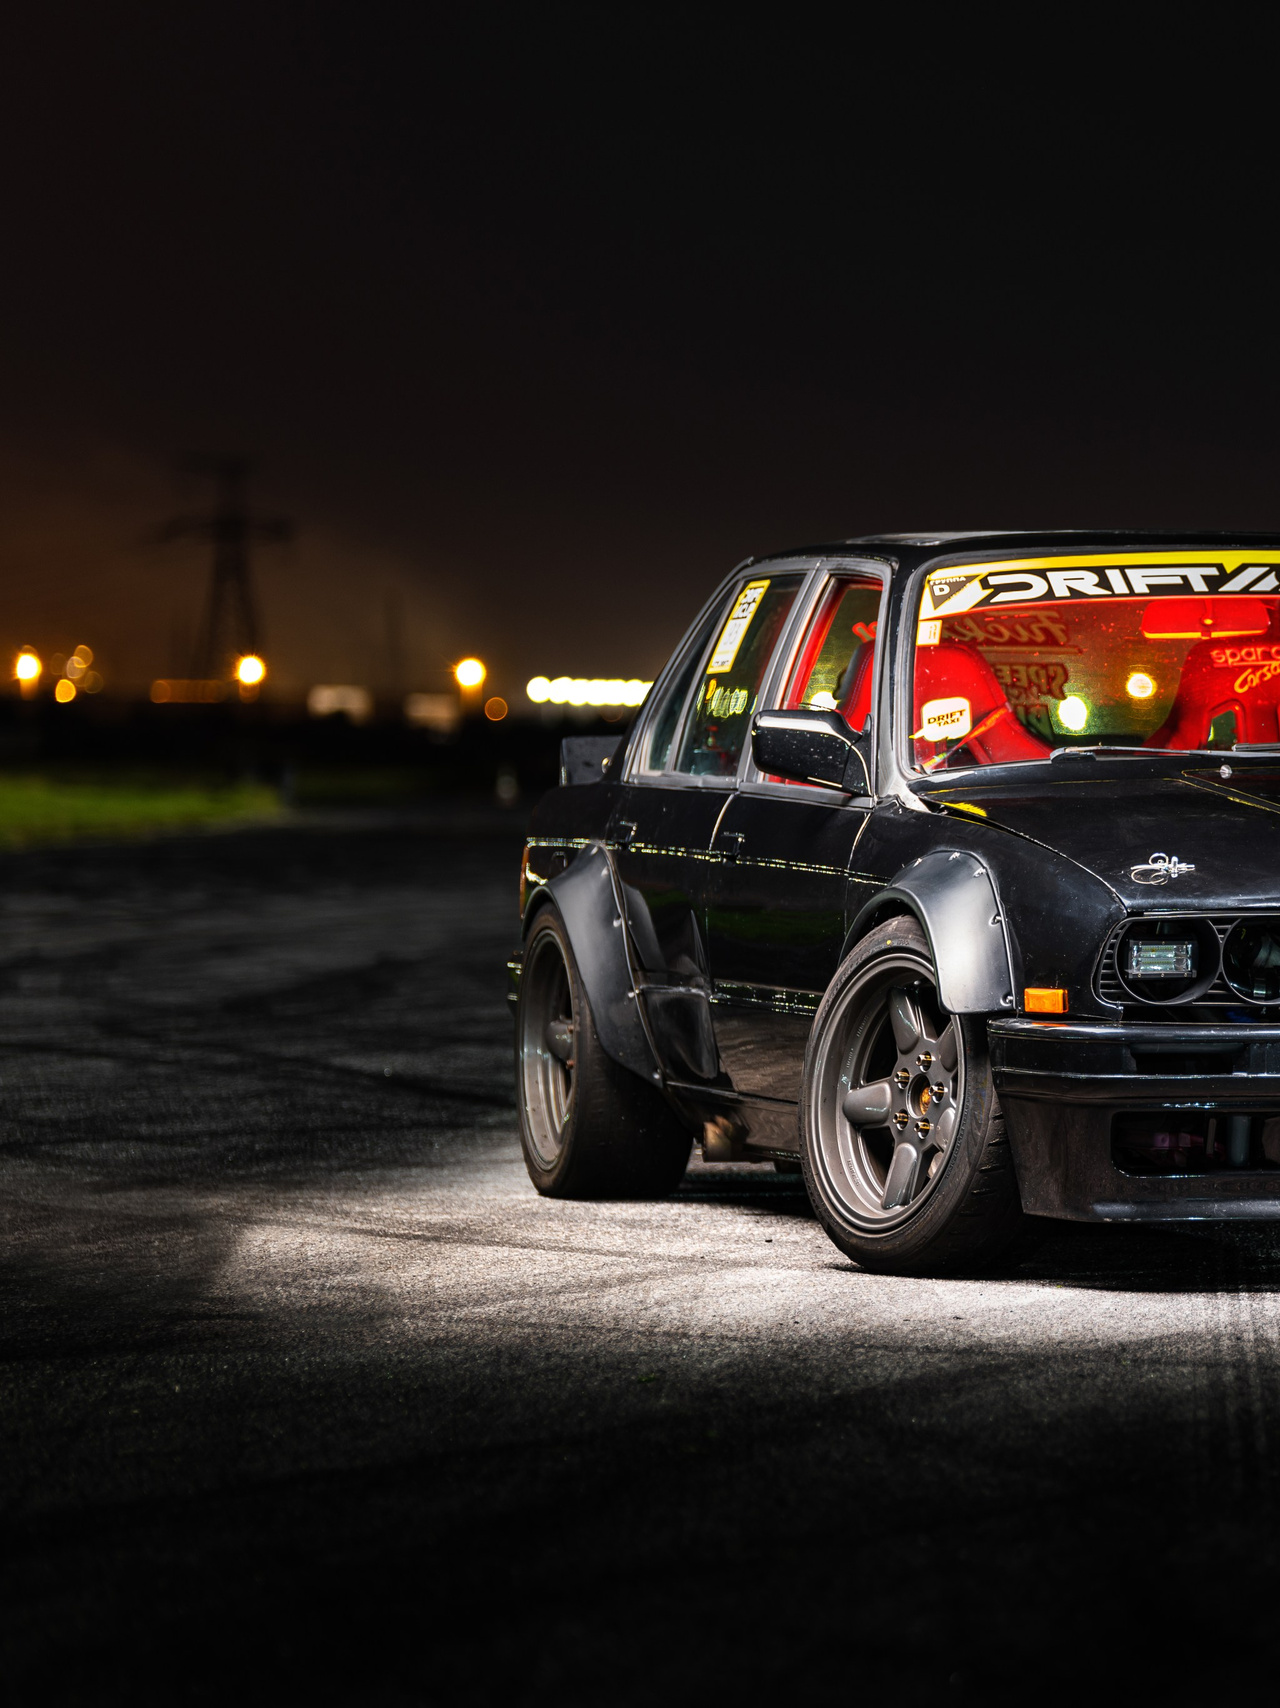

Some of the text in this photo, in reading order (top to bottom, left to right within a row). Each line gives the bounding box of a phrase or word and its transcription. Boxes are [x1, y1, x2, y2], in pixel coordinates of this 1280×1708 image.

[987, 567, 1220, 603] DRIFT
[927, 708, 967, 725] DRIFT
[936, 717, 960, 727] TAXI
